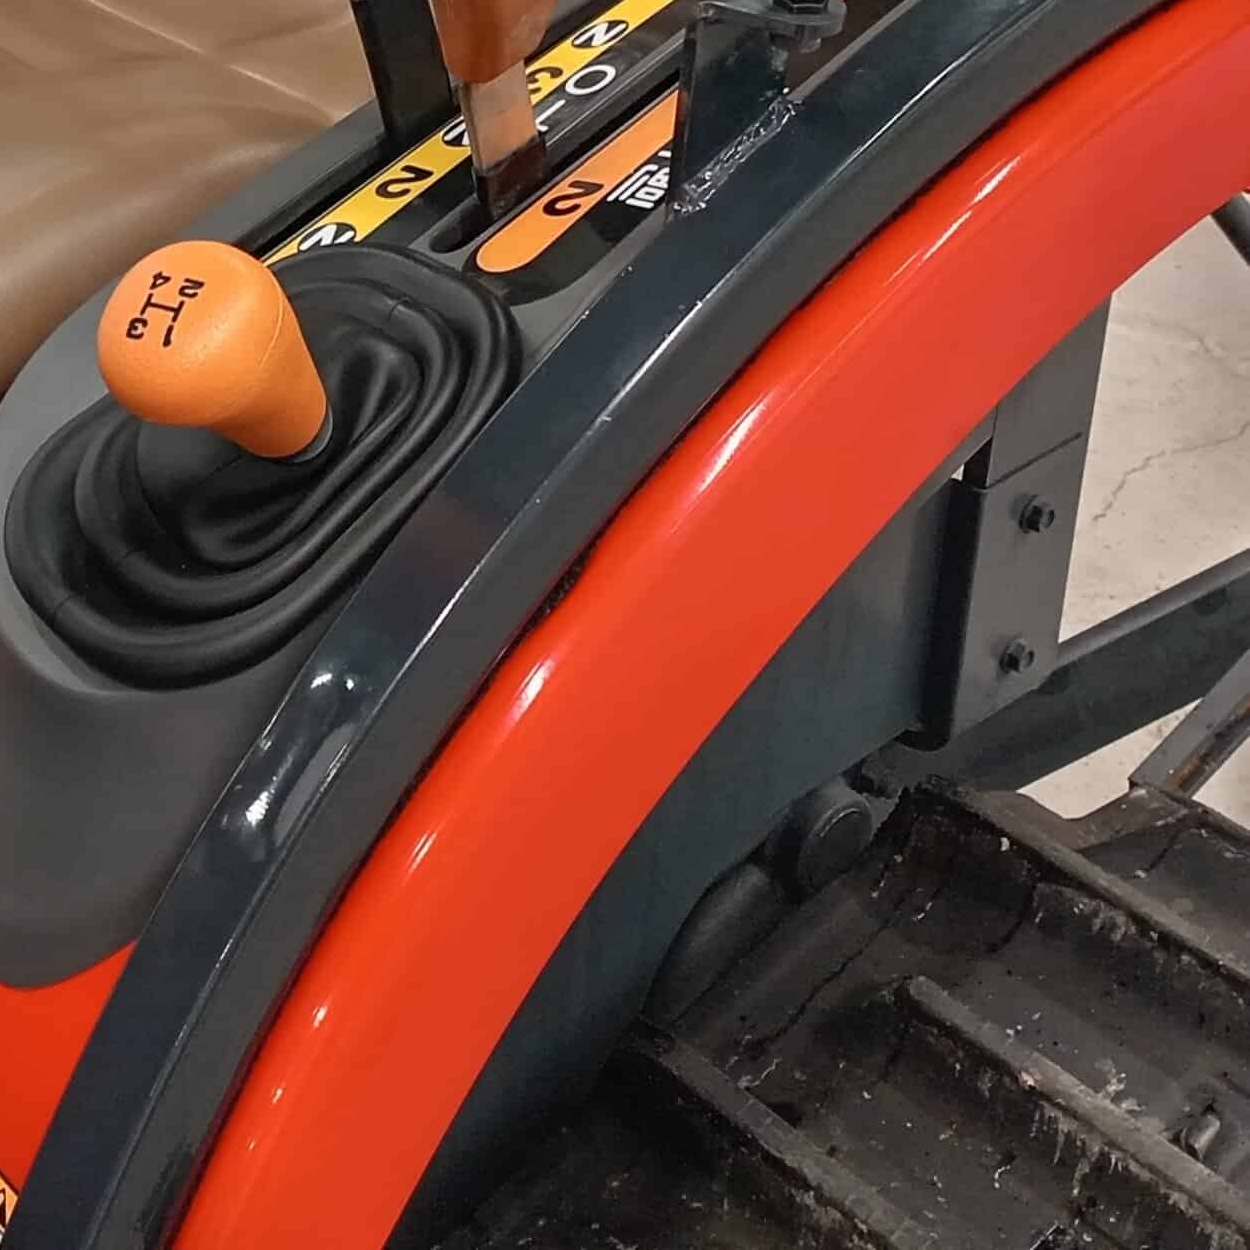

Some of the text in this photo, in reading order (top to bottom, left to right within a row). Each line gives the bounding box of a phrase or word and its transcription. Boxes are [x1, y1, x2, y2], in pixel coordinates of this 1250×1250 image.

[573, 21, 627, 47] N
[375, 165, 433, 198] 2
[542, 180, 604, 217] 2
[150, 271, 204, 299] 4 2
[126, 318, 175, 348] 3 1
